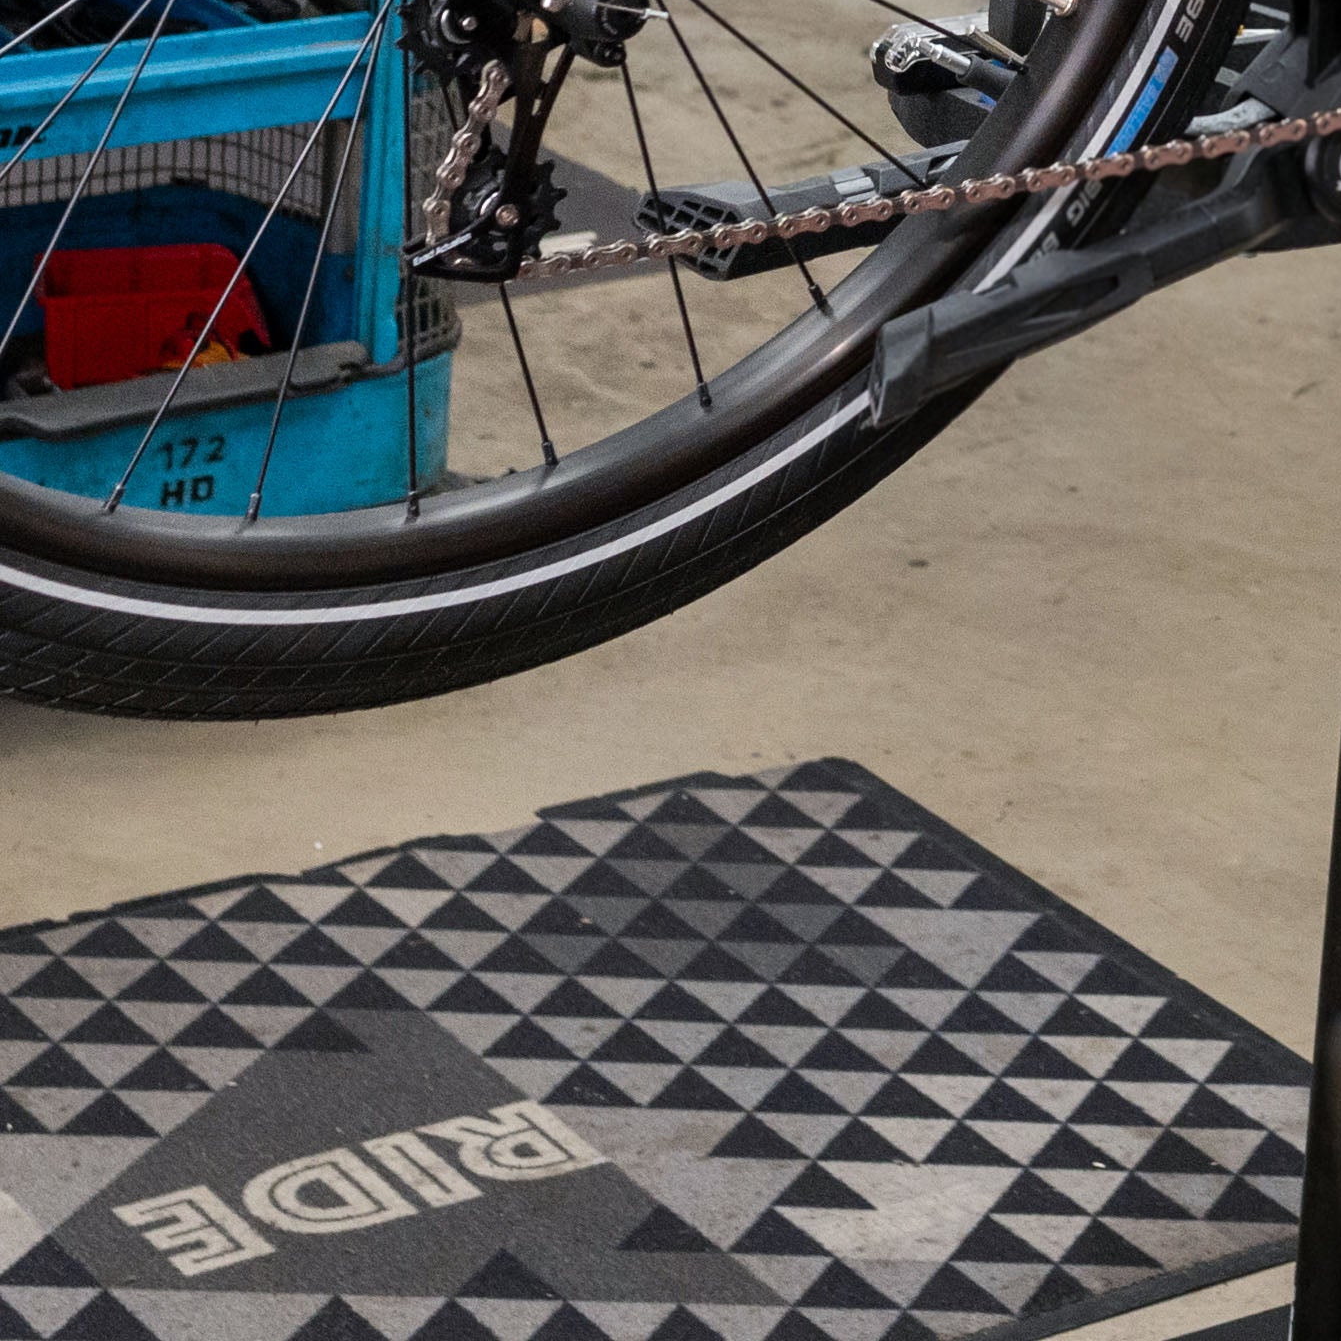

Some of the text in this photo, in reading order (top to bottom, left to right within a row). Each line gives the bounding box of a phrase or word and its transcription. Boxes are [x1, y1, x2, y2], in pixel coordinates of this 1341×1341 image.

[161, 436, 225, 470] 172
[160, 477, 216, 506] HD
[112, 1100, 608, 1276] RIDE
